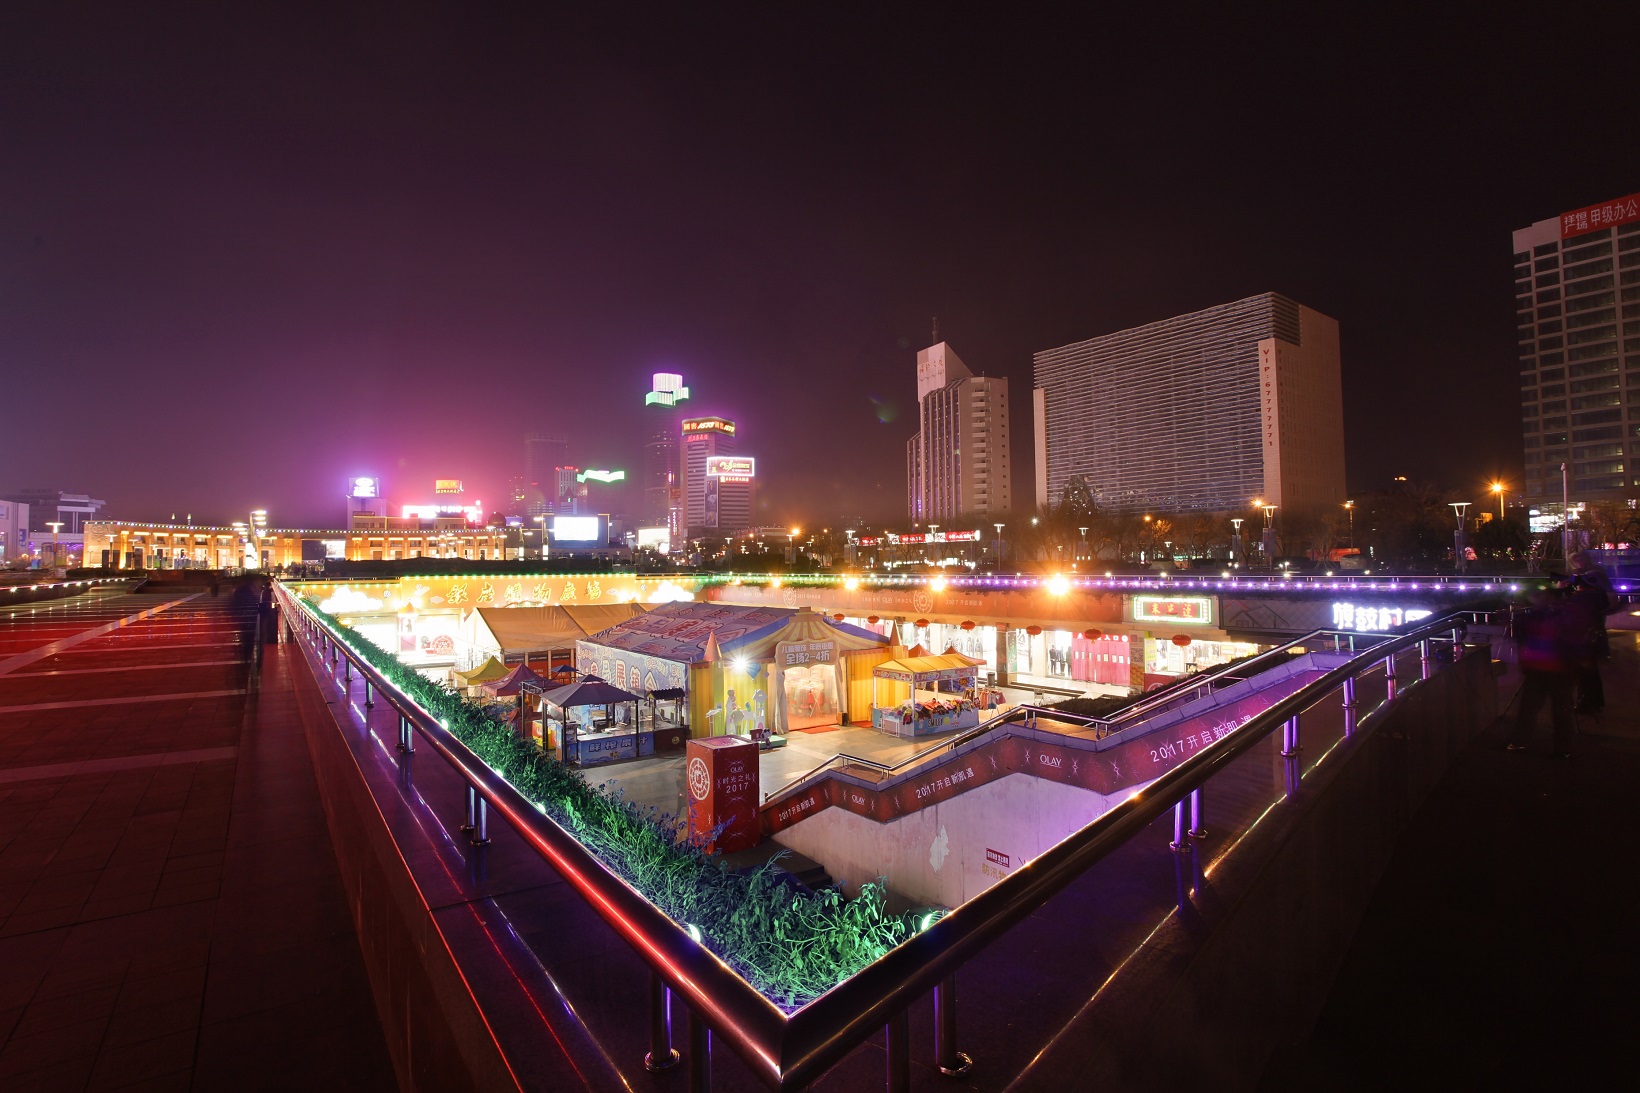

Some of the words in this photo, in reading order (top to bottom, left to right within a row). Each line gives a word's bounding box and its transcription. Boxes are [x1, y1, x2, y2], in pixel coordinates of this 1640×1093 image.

[1590, 199, 1638, 227] 甲级办公
[1564, 221, 1588, 234] 广场
[786, 650, 830, 665] 全场2-4折
[927, 717, 943, 728] SMILEY
[1039, 754, 1062, 767] OLAY
[730, 766, 744, 774] OLAY
[722, 774, 751, 785] 时光之礼
[726, 782, 749, 794] 2017
[851, 794, 866, 806] OLAY
